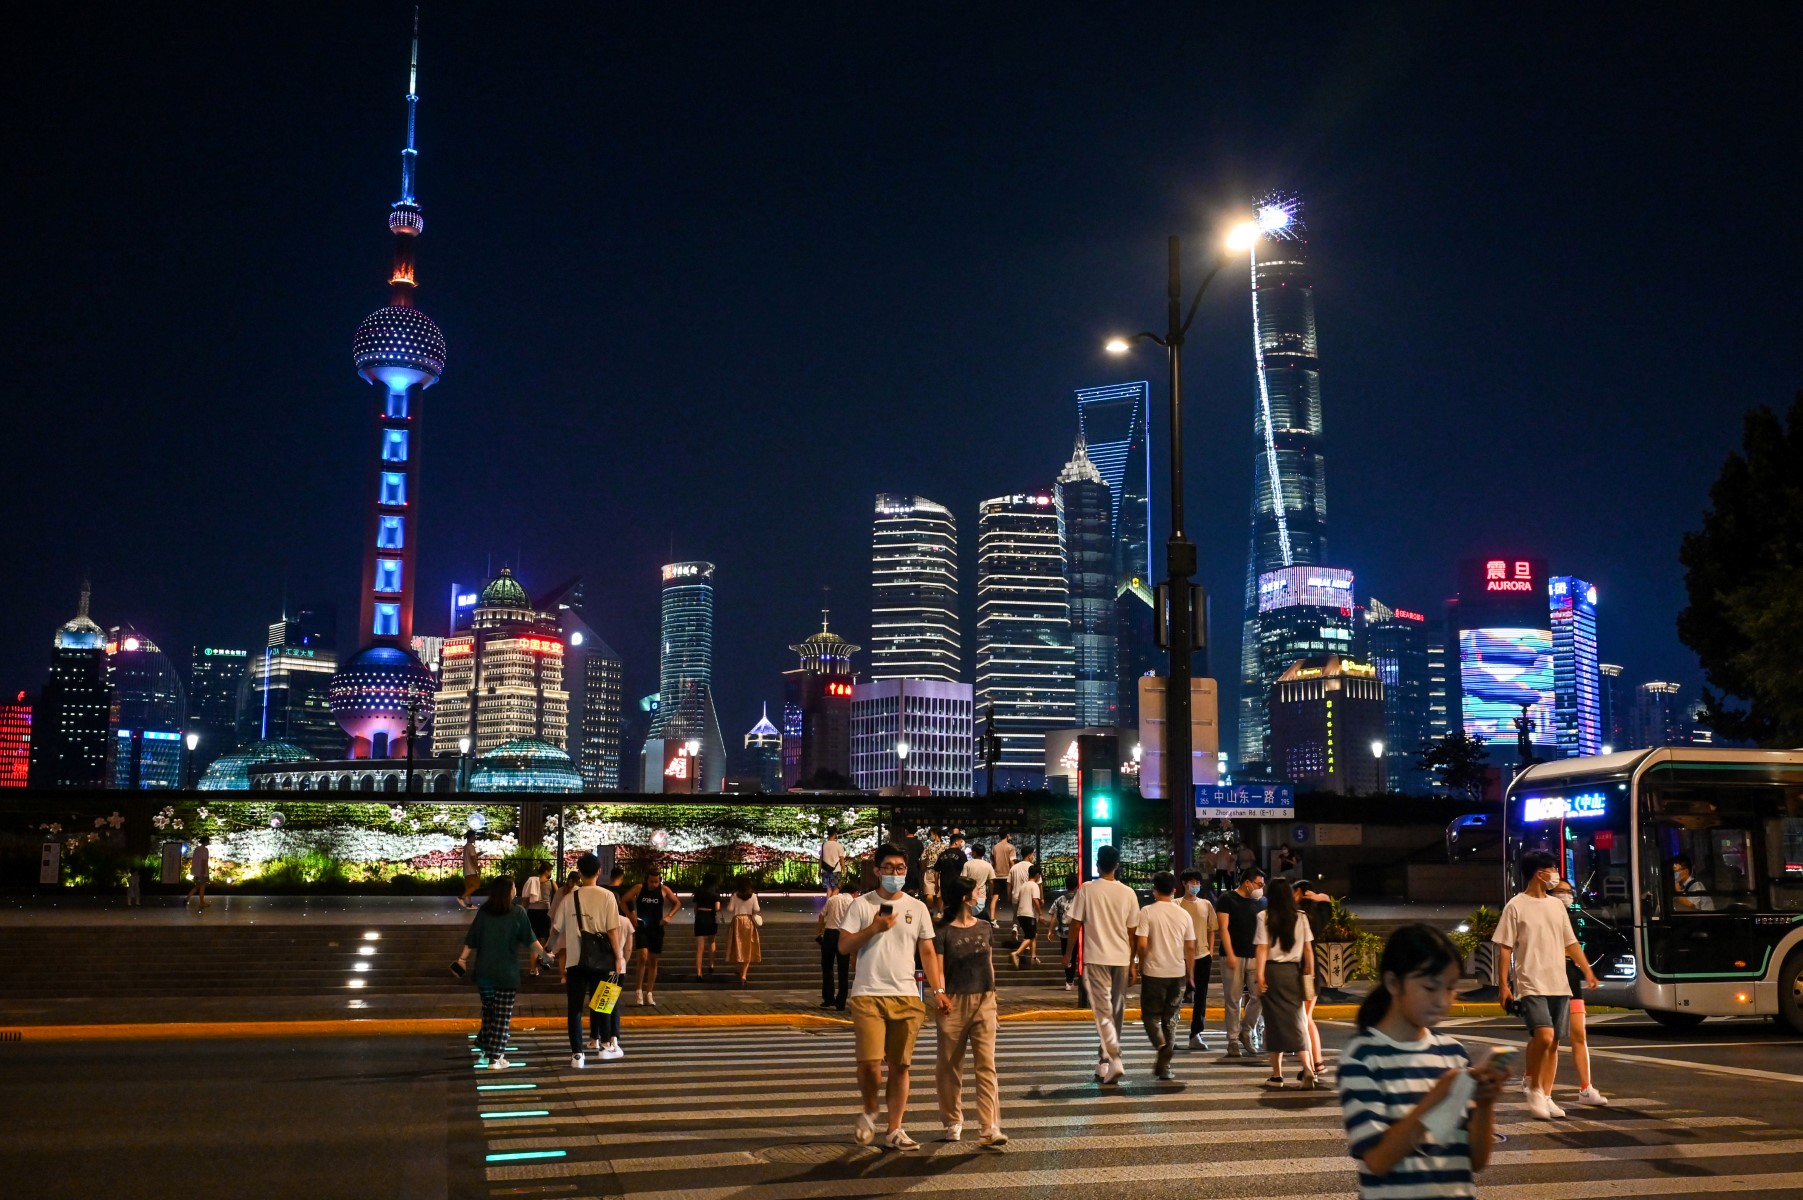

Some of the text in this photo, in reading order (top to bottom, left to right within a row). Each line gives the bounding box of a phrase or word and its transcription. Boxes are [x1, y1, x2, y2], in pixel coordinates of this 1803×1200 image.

[1487, 561, 1531, 579] 震旦
[1487, 581, 1532, 591] AURORA
[519, 637, 562, 652] 中国平安
[1214, 789, 1275, 804] 中山东一路
